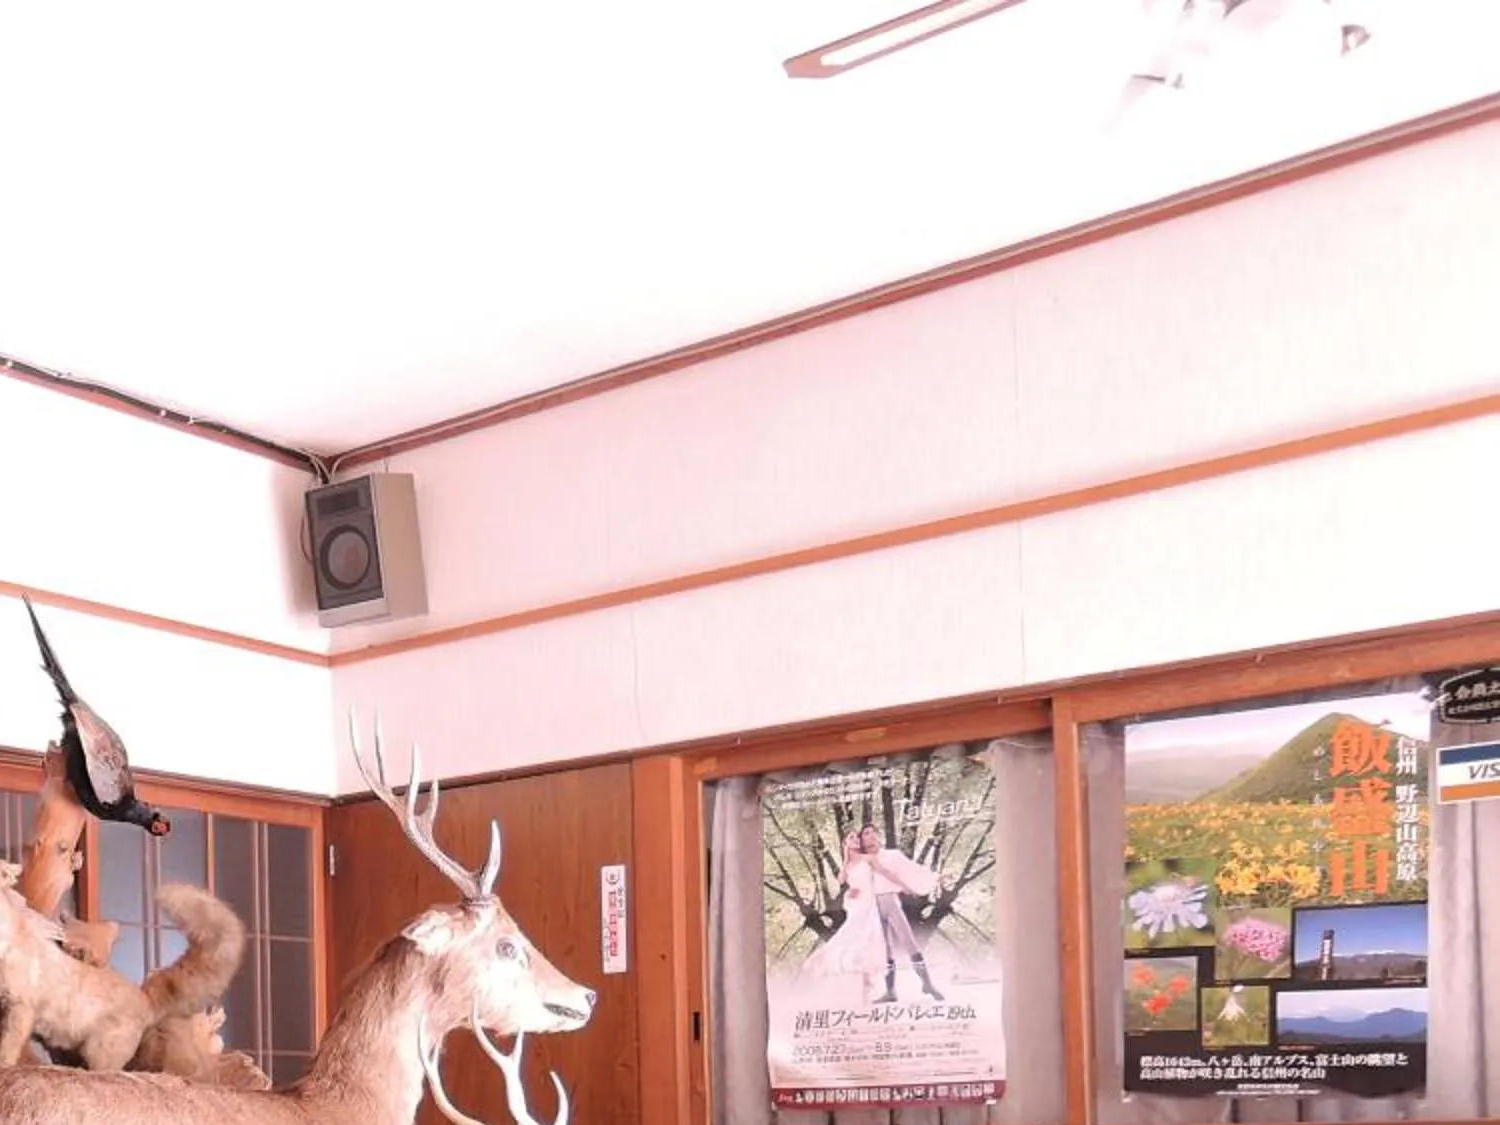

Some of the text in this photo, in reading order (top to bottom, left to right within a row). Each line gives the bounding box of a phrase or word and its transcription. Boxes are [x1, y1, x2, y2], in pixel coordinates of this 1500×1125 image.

[1329, 716, 1393, 897] 飯盛山
[1395, 736, 1418, 881] 信州 野辺山高原
